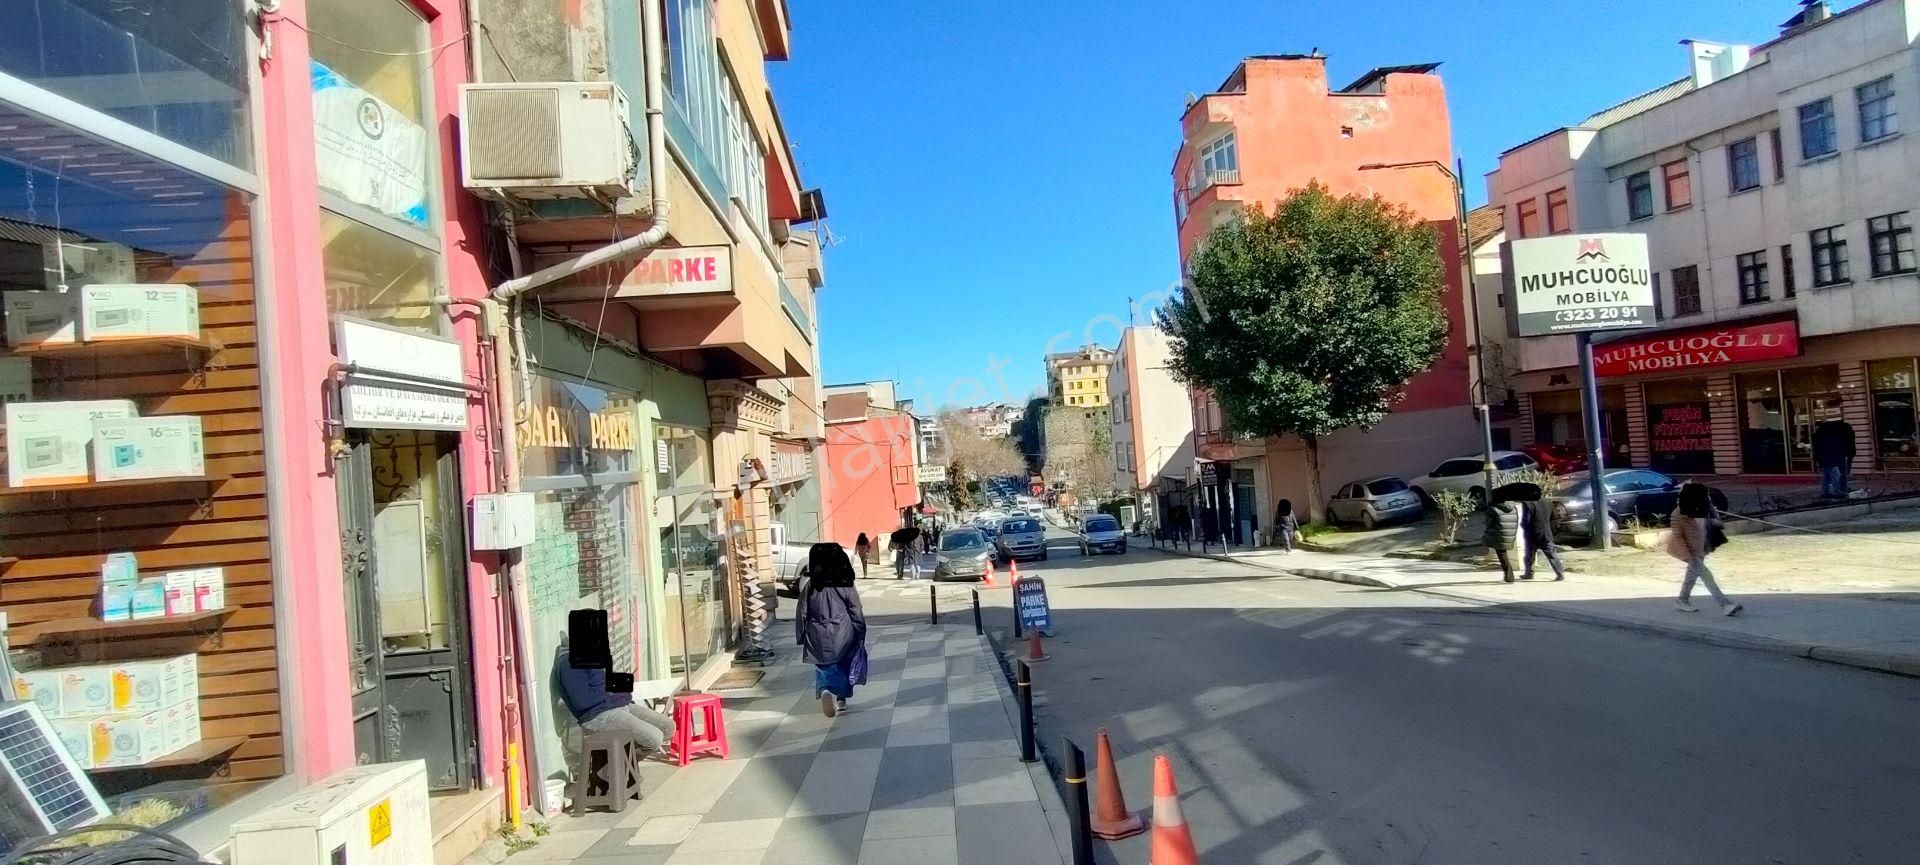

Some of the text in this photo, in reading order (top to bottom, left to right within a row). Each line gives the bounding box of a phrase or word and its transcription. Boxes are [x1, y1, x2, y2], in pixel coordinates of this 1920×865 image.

[634, 256, 717, 284] PARKE
[1521, 264, 1648, 294] MUHCUOĞLU
[145, 290, 158, 301] 12
[1556, 288, 1629, 306] MOBİLYA
[1563, 306, 1638, 322] 323 20 91
[1594, 332, 1785, 367] MUHCUOĞLU
[1628, 350, 1731, 372] MOBİLYA
[149, 427, 163, 438] 16
[1020, 581, 1042, 593] ŞAHİN
[1021, 594, 1045, 607] PARKE
